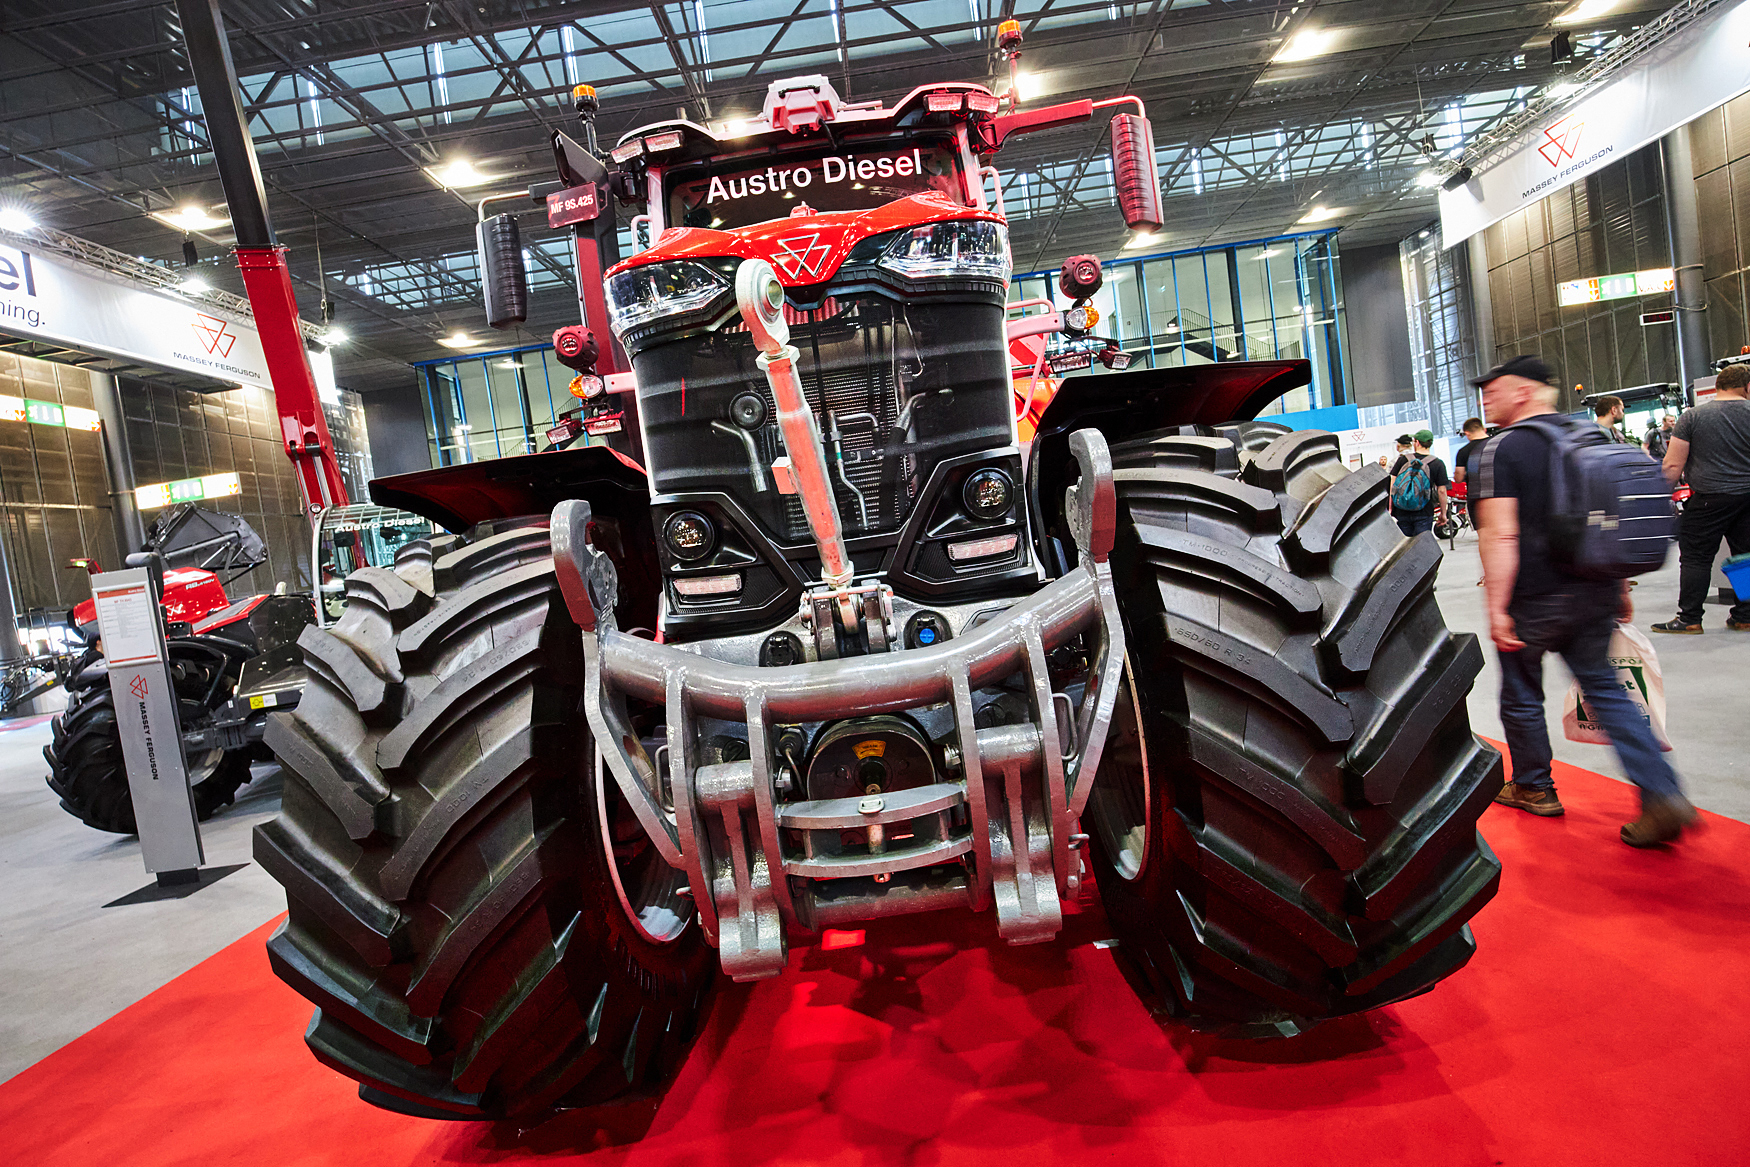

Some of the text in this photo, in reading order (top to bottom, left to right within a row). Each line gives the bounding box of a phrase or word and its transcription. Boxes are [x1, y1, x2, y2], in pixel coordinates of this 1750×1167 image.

[706, 149, 922, 204] Austro Diesel
[1522, 145, 1614, 199] MASSEY FERGUSON
[550, 194, 594, 214] MF 9S.425
[172, 351, 262, 380] MASSEY FERGUSON
[335, 516, 425, 534] Austro Diesel
[138, 701, 159, 781] MASSEY FERGUSON
